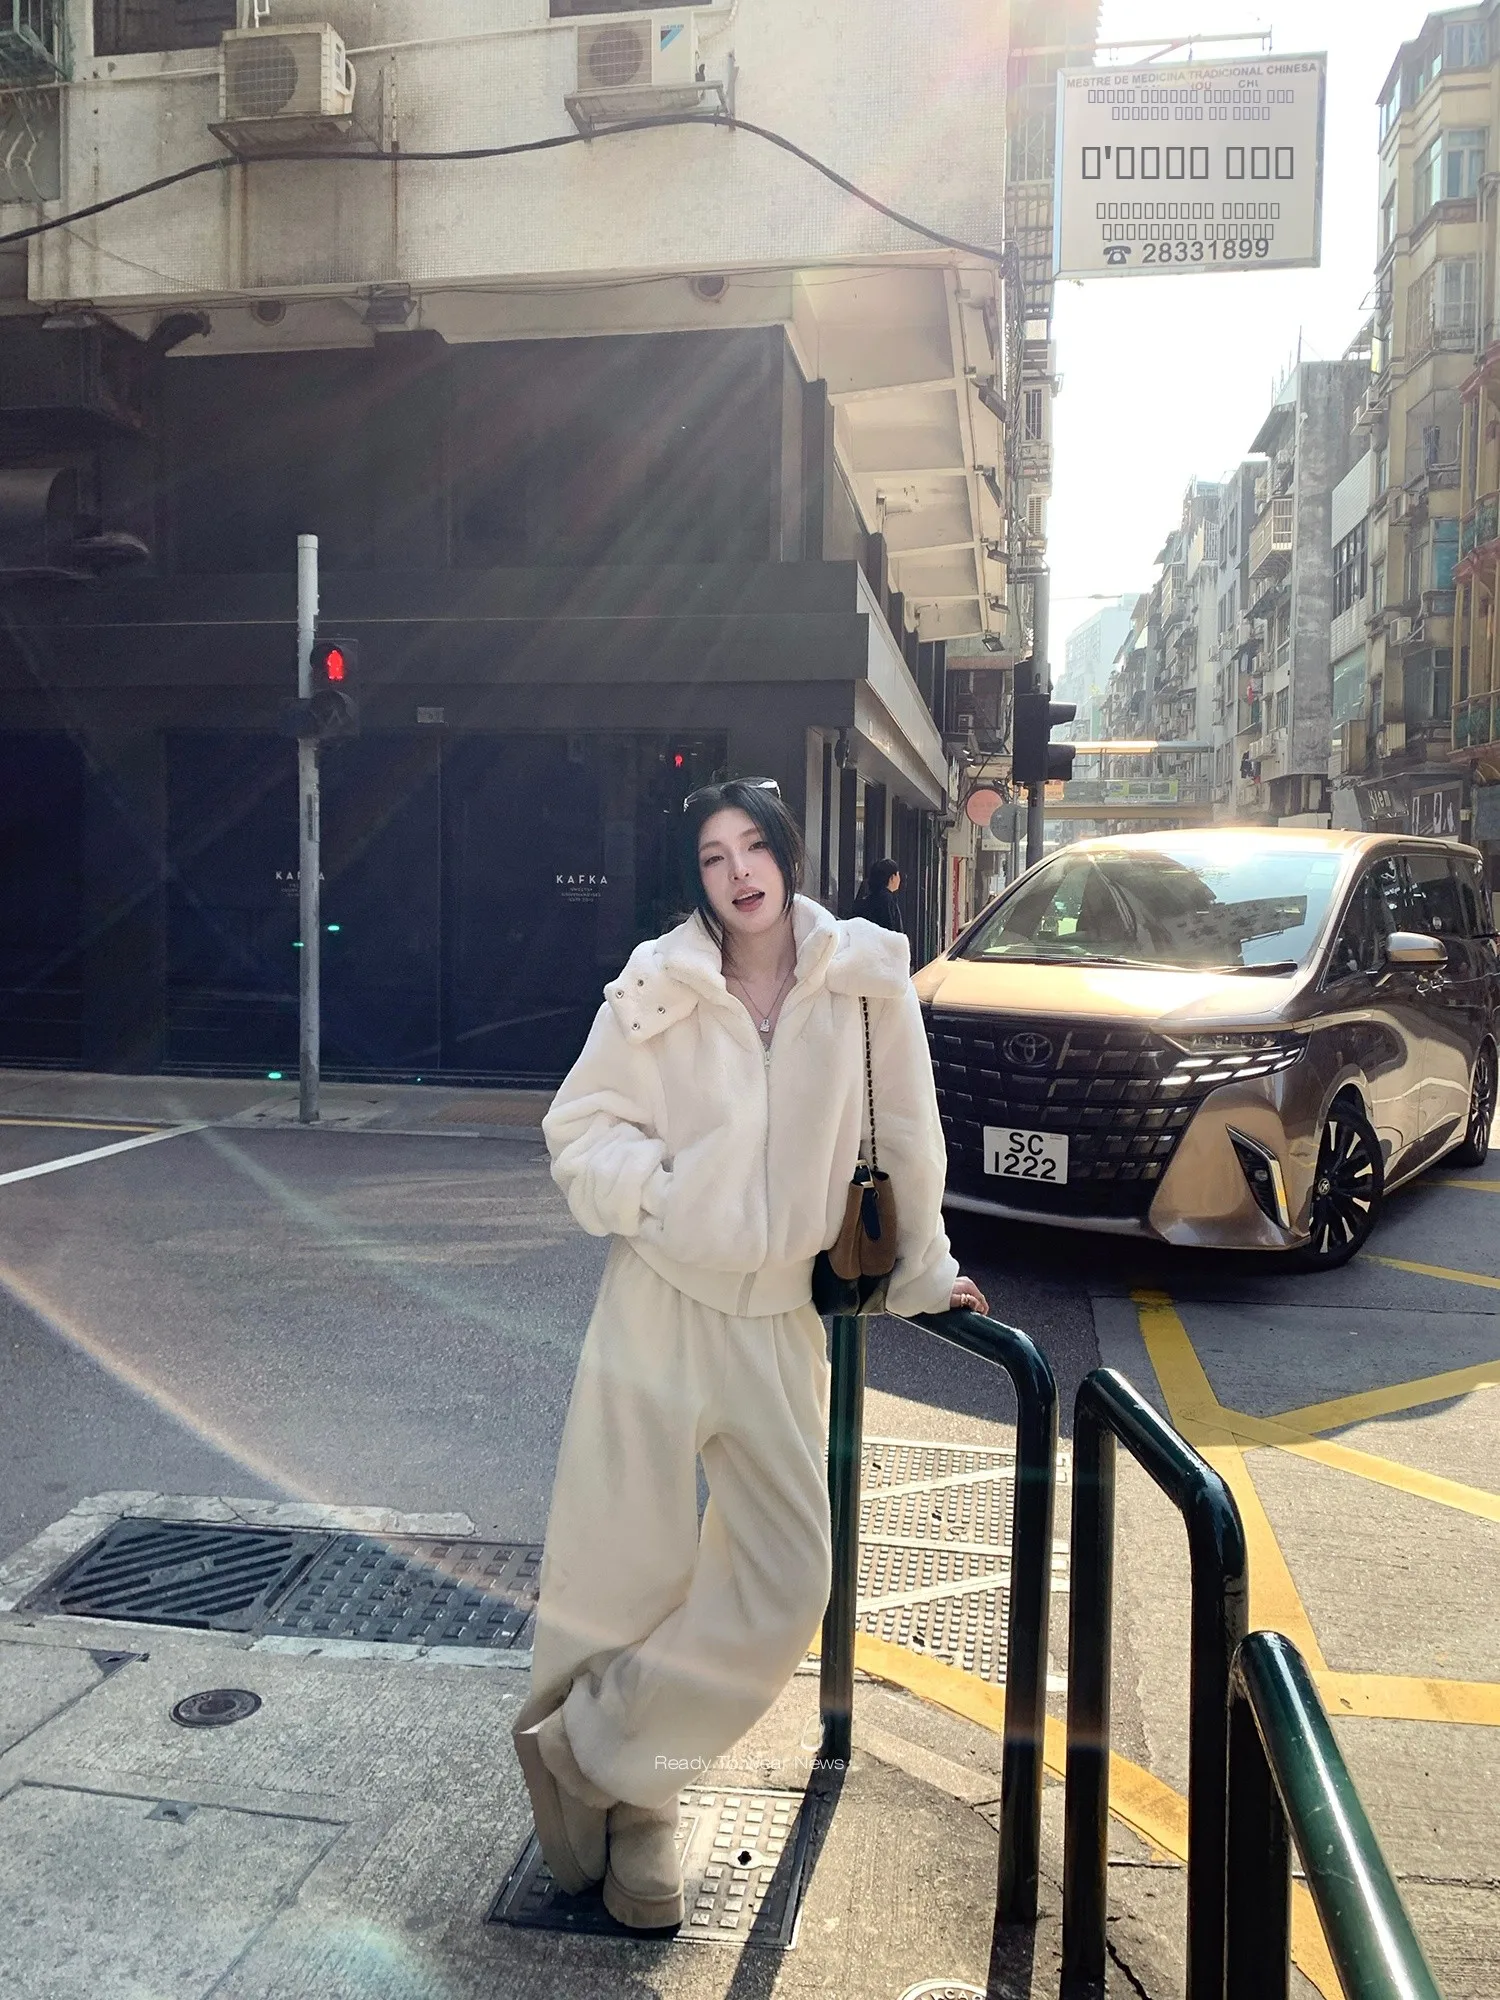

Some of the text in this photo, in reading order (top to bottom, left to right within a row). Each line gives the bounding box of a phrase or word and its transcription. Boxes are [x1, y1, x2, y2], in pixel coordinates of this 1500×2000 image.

[1066, 62, 1318, 89] MESTRE DE MEDICINA TRADICIONAL CHINESA
[1141, 238, 1270, 264] 28331899
[556, 874, 608, 885] KAFKA
[1008, 1131, 1044, 1156] SC
[994, 1151, 1057, 1181] 1222
